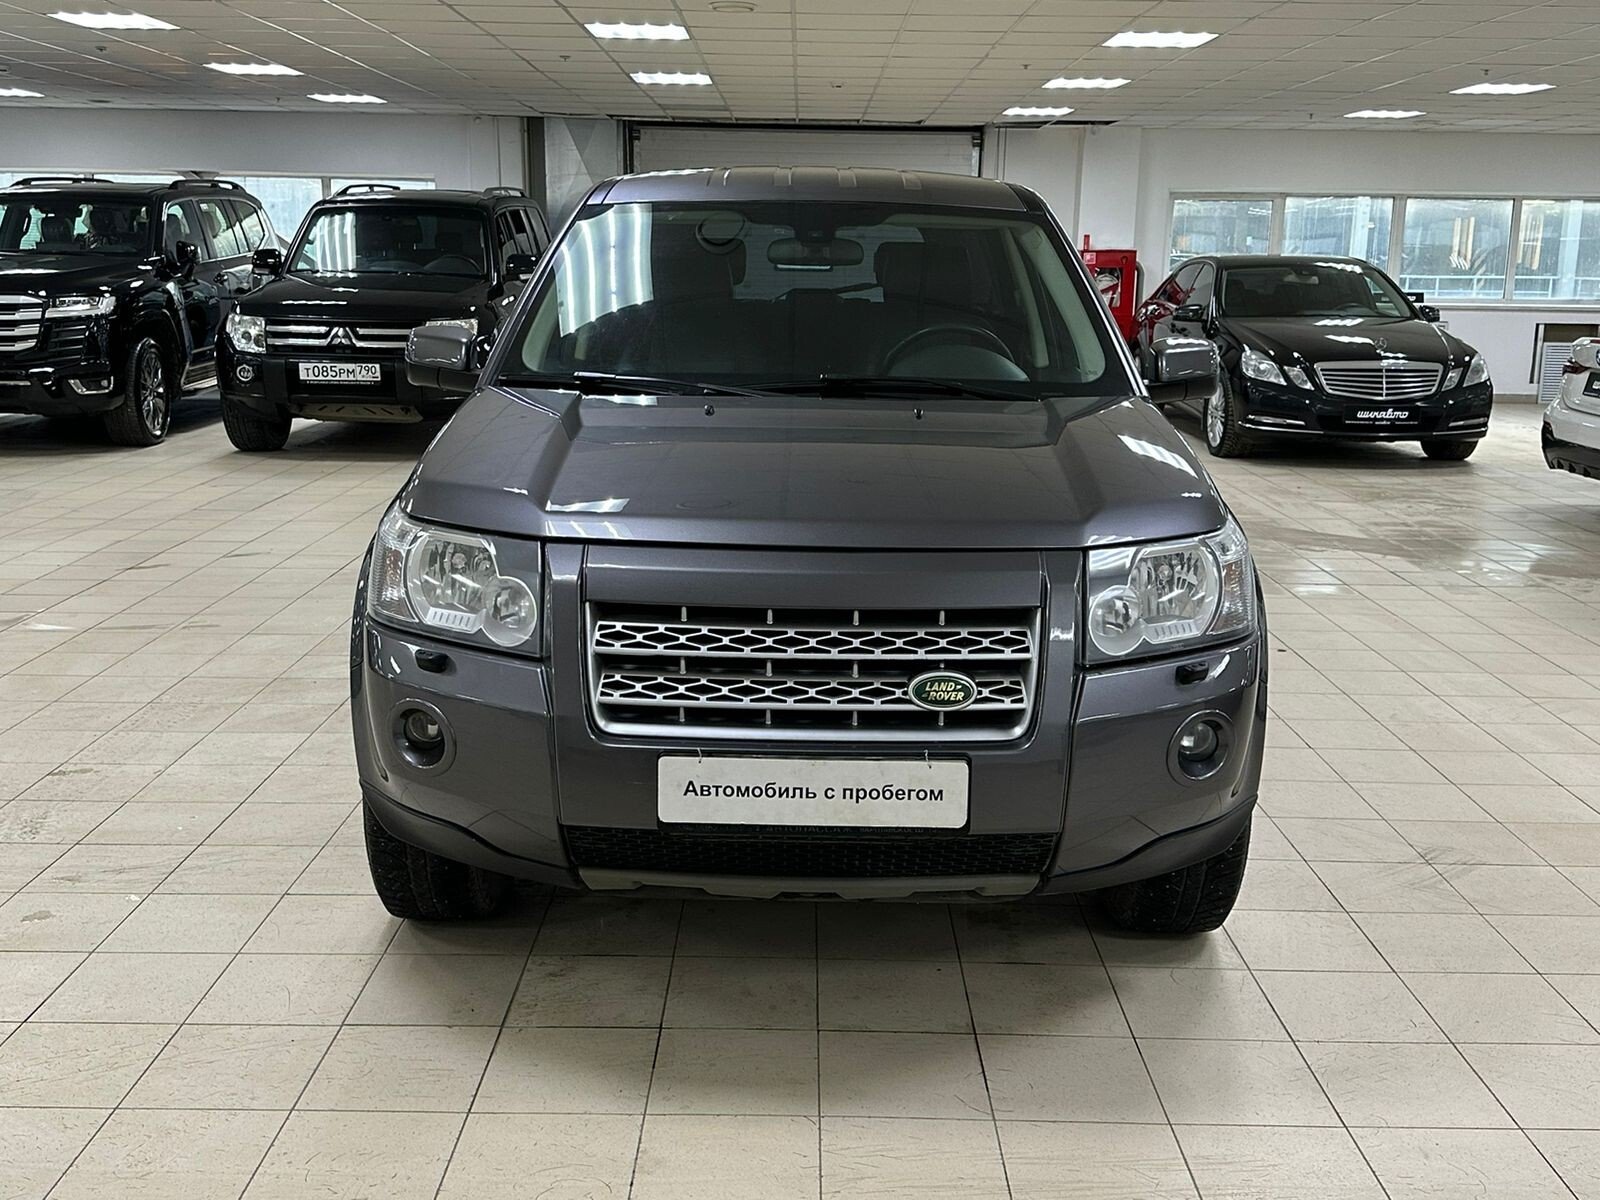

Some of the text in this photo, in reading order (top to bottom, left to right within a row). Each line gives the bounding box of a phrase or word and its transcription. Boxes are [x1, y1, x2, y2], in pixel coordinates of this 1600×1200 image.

[357, 365, 377, 375] 790
[925, 682, 955, 691] LAND
[927, 692, 965, 701] ROVER
[683, 780, 944, 803] Автомобиль с пробегом
